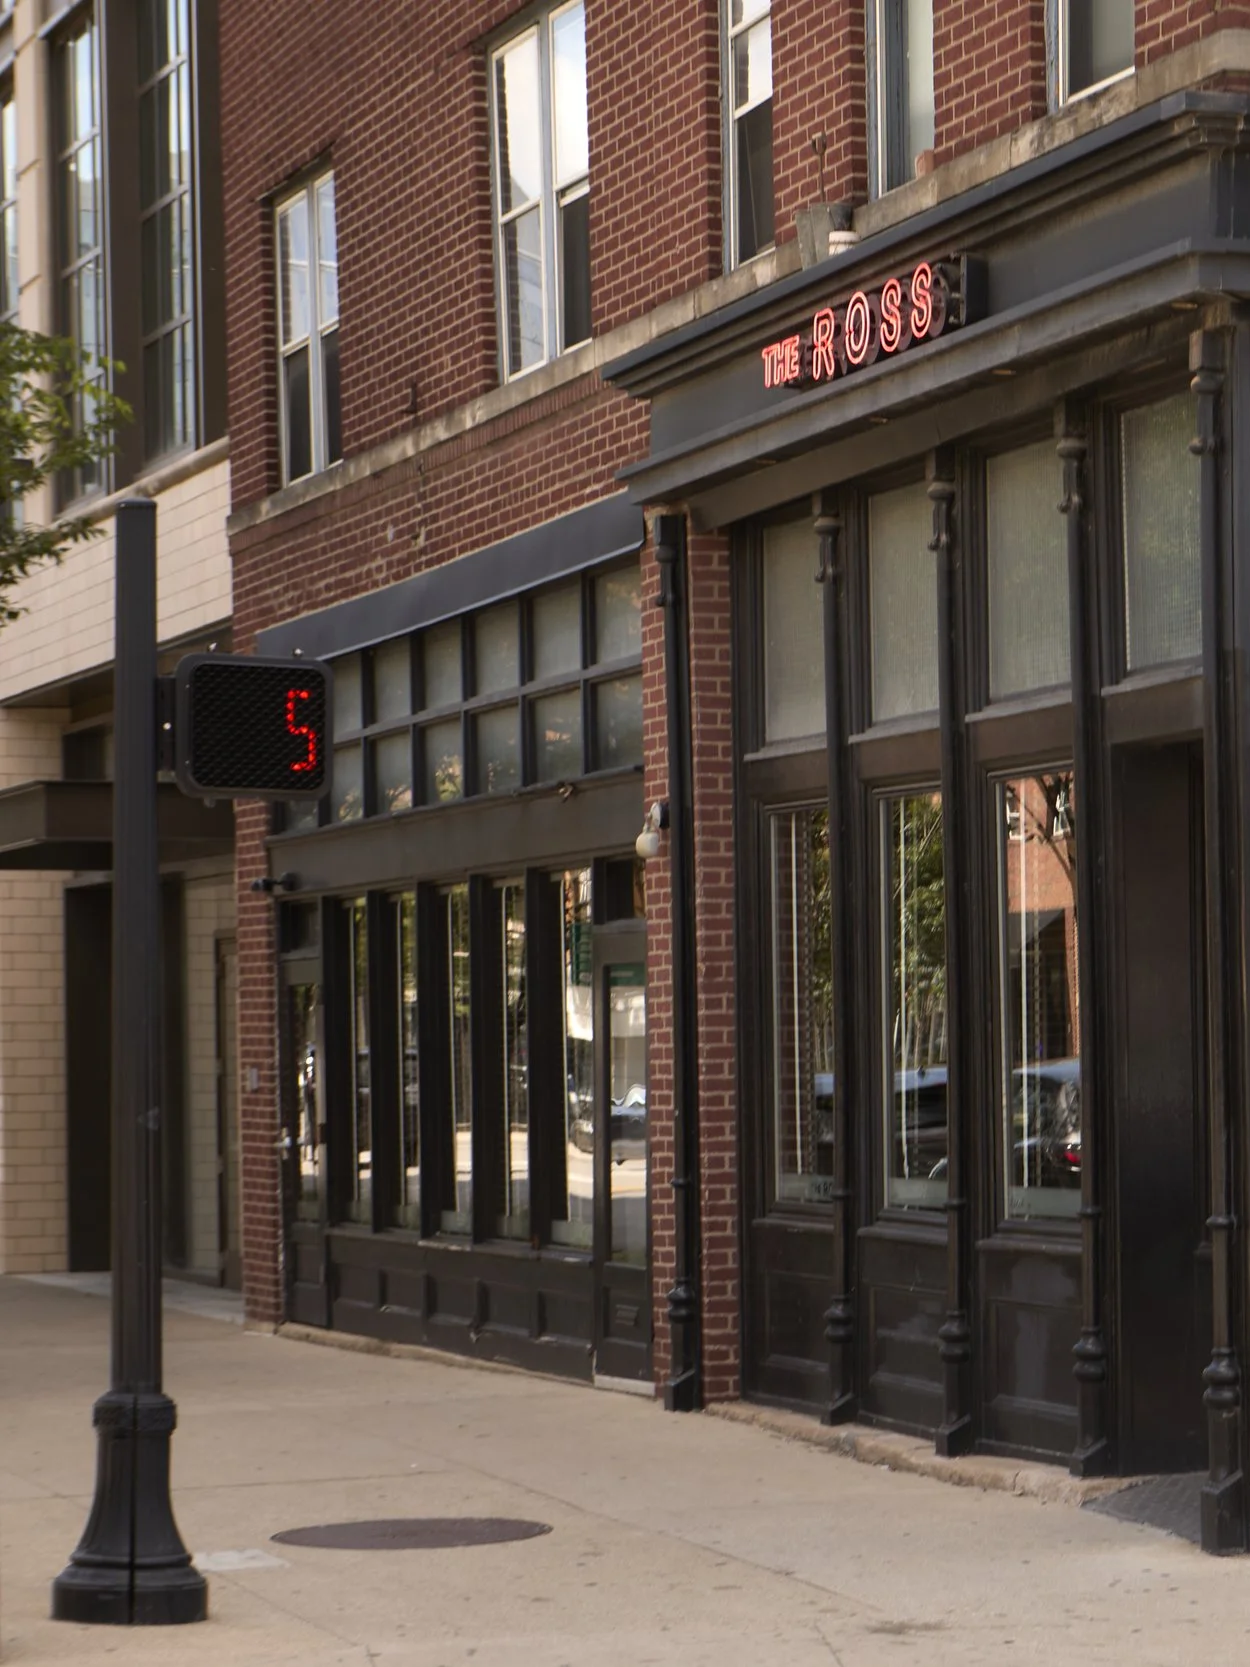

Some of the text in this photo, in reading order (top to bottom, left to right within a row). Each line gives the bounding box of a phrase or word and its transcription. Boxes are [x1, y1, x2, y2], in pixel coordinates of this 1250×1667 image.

[761, 261, 933, 389] THE ROSS
[286, 689, 318, 772] 5
